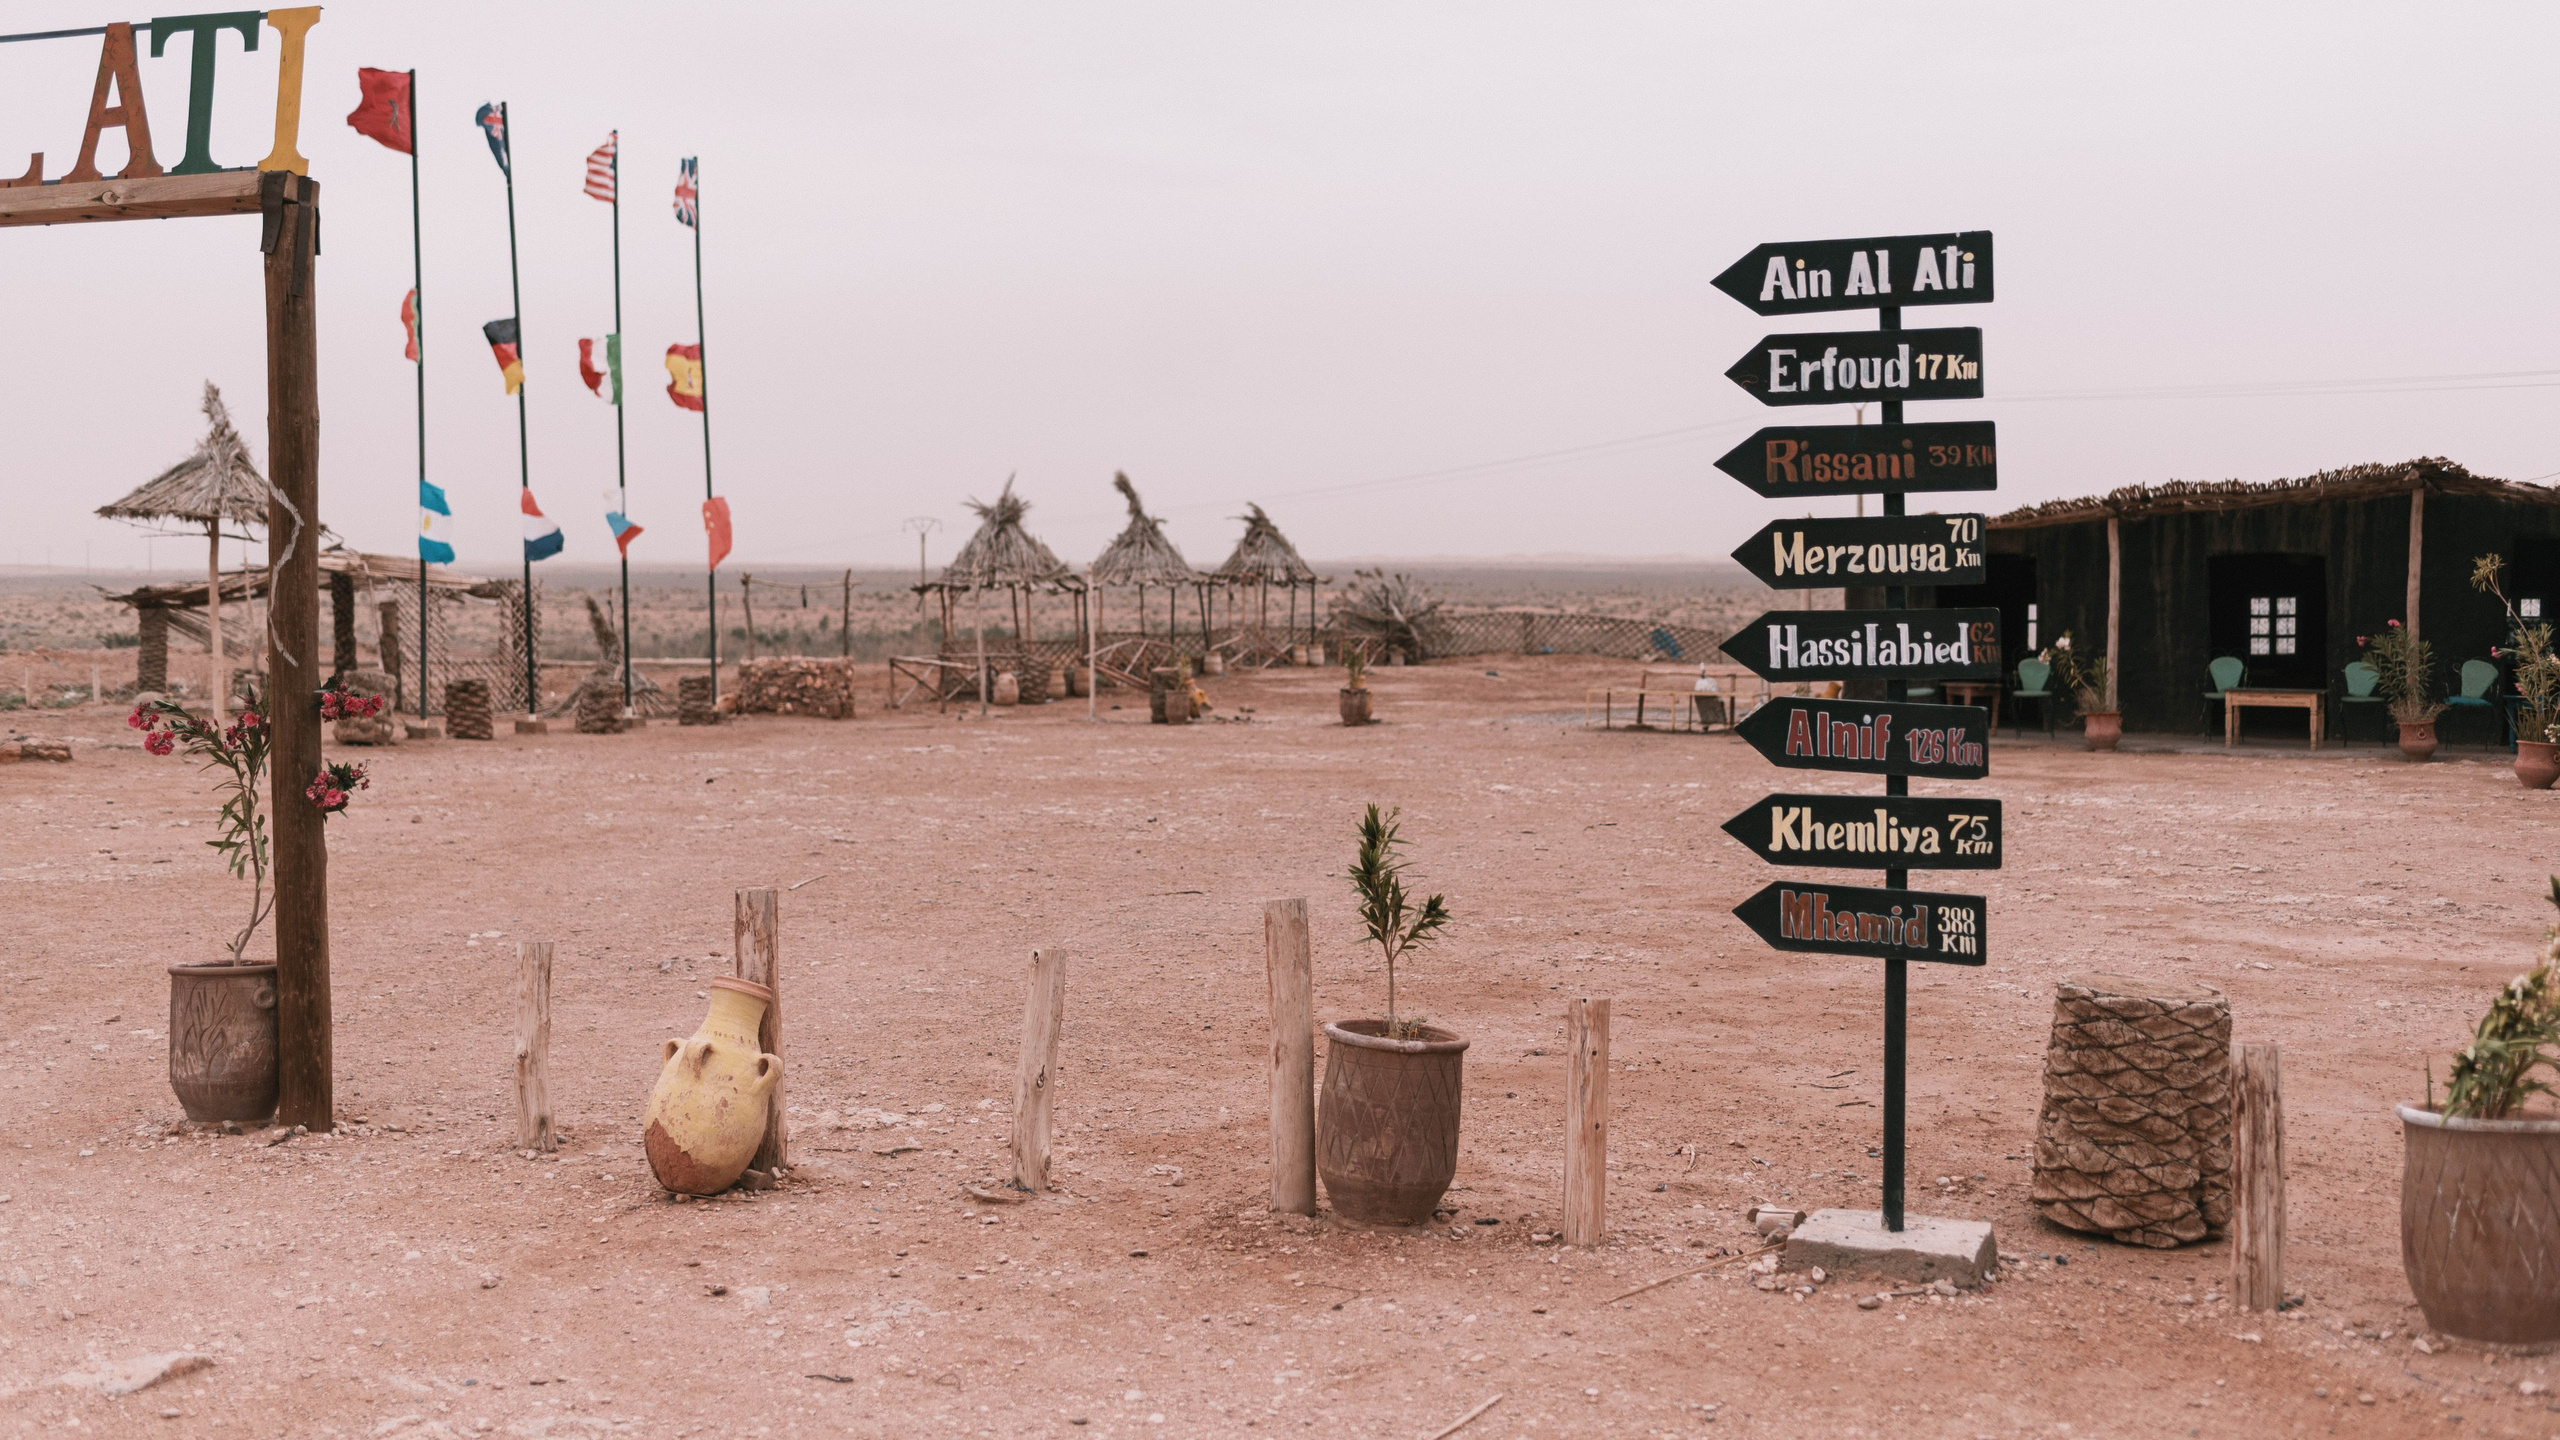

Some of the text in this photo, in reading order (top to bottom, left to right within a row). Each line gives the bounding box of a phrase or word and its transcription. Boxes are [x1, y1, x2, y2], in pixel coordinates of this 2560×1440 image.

[1759, 245, 1975, 301] Ain Al Ati
[1767, 343, 1978, 393] Erfoud 17 Km
[1765, 438, 1916, 484] Rissani
[1928, 444, 1962, 467] 39
[1946, 517, 1978, 544] 70
[1773, 531, 1951, 577] Merzouga
[1955, 548, 1981, 568] Km
[1767, 622, 1971, 669] Hassilabied
[1970, 621, 1996, 642] 62
[1786, 708, 1983, 767] Alnif 126 Km
[1768, 806, 1941, 855] Khemliya
[1948, 814, 1989, 841] 75
[1956, 838, 1993, 855] Km
[1780, 889, 1929, 949] Mhamid
[1937, 906, 1976, 935] 388
